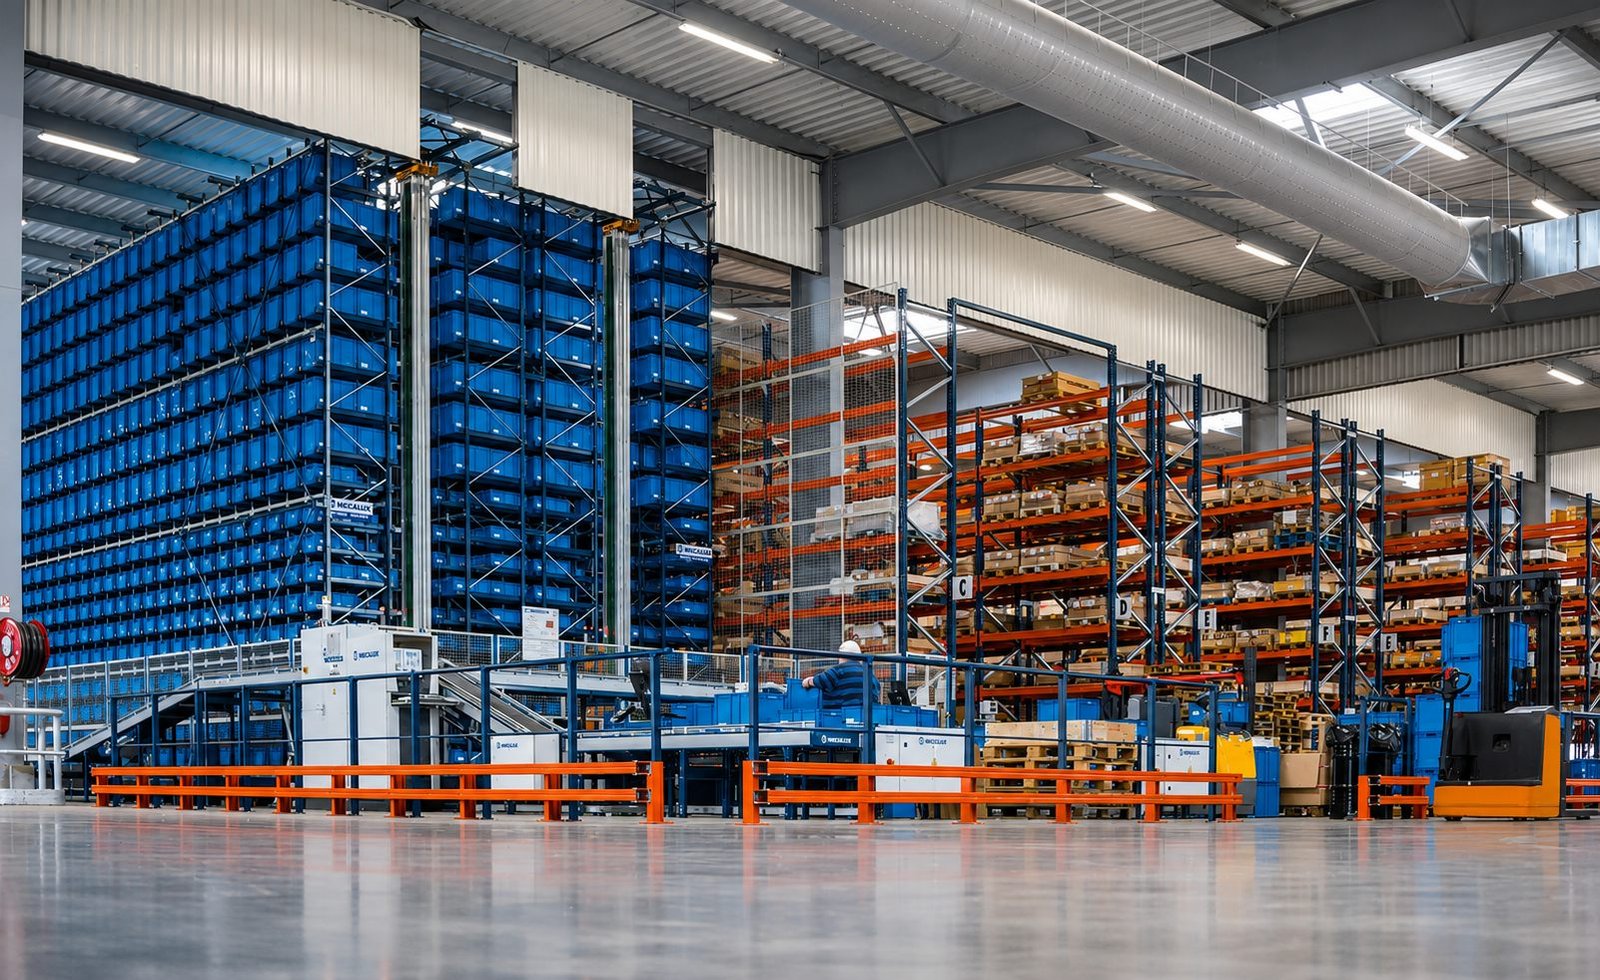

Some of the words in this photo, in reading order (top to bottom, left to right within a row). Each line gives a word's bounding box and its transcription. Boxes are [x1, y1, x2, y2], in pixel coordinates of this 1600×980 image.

[959, 579, 967, 597] C
[1120, 600, 1127, 616] D
[1204, 611, 1210, 627] E
[1323, 626, 1329, 641] F
